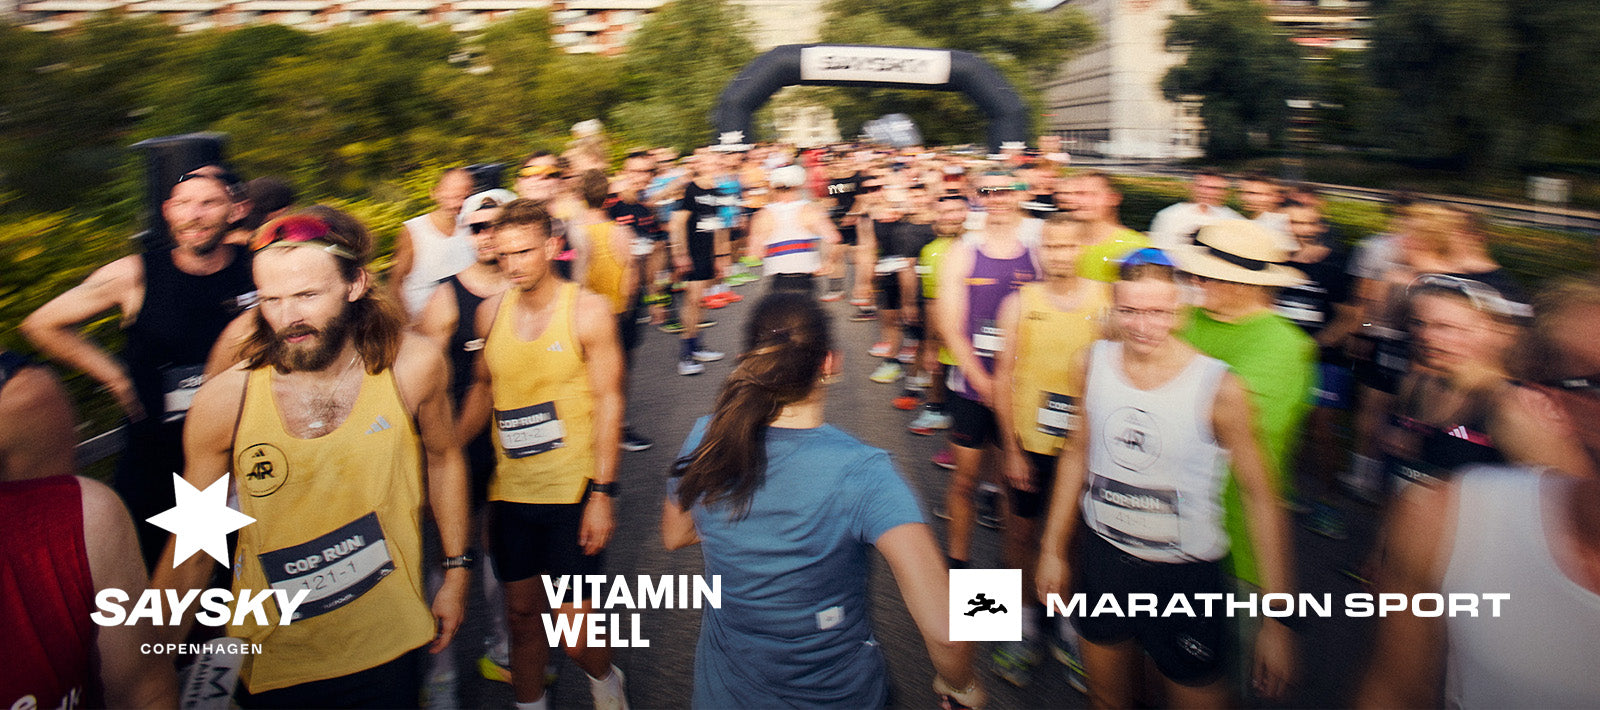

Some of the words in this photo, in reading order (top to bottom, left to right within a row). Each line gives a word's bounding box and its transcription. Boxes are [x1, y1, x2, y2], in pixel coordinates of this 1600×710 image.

[499, 418, 520, 429] COP
[1104, 490, 1134, 507] COP
[1134, 495, 1161, 510] RUN
[284, 554, 322, 575] COP
[322, 535, 366, 562] RUN
[302, 560, 356, 590] 121-1
